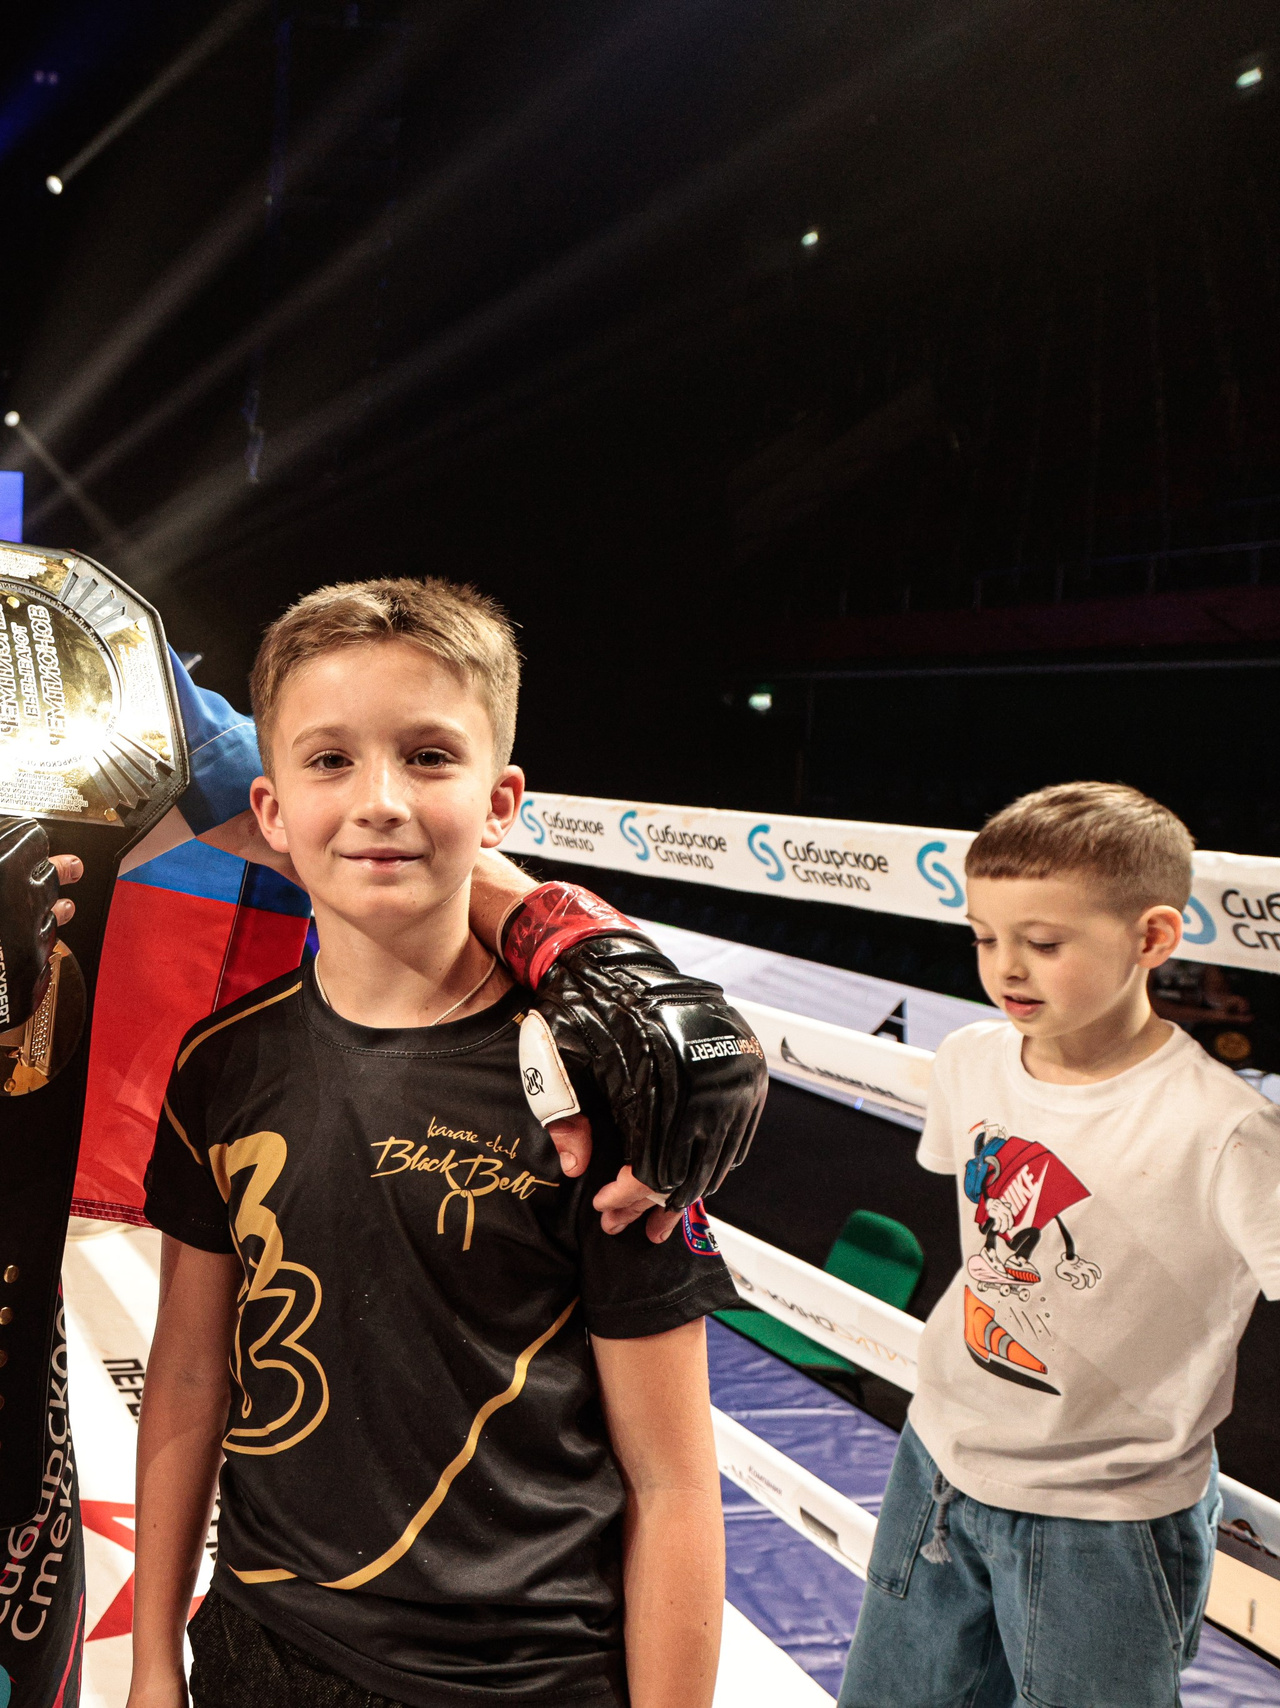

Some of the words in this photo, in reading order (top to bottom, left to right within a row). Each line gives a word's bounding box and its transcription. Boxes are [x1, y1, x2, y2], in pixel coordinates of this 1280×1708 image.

[11, 622, 38, 717] ВЫЗЫВАЮТ
[28, 605, 66, 745] ЧЕМПИОНОВ
[542, 811, 605, 836] Сибирское
[549, 830, 595, 852] Стекло
[647, 824, 727, 852] Сибирское
[655, 845, 714, 870] Стекло
[783, 840, 889, 873] Сибирское
[793, 864, 871, 892] Стекло
[689, 1039, 755, 1061] FIGHTEXPERT
[427, 1116, 479, 1144] karate
[486, 1135, 520, 1160] club
[370, 1136, 460, 1181] Black
[459, 1154, 560, 1200] Belt
